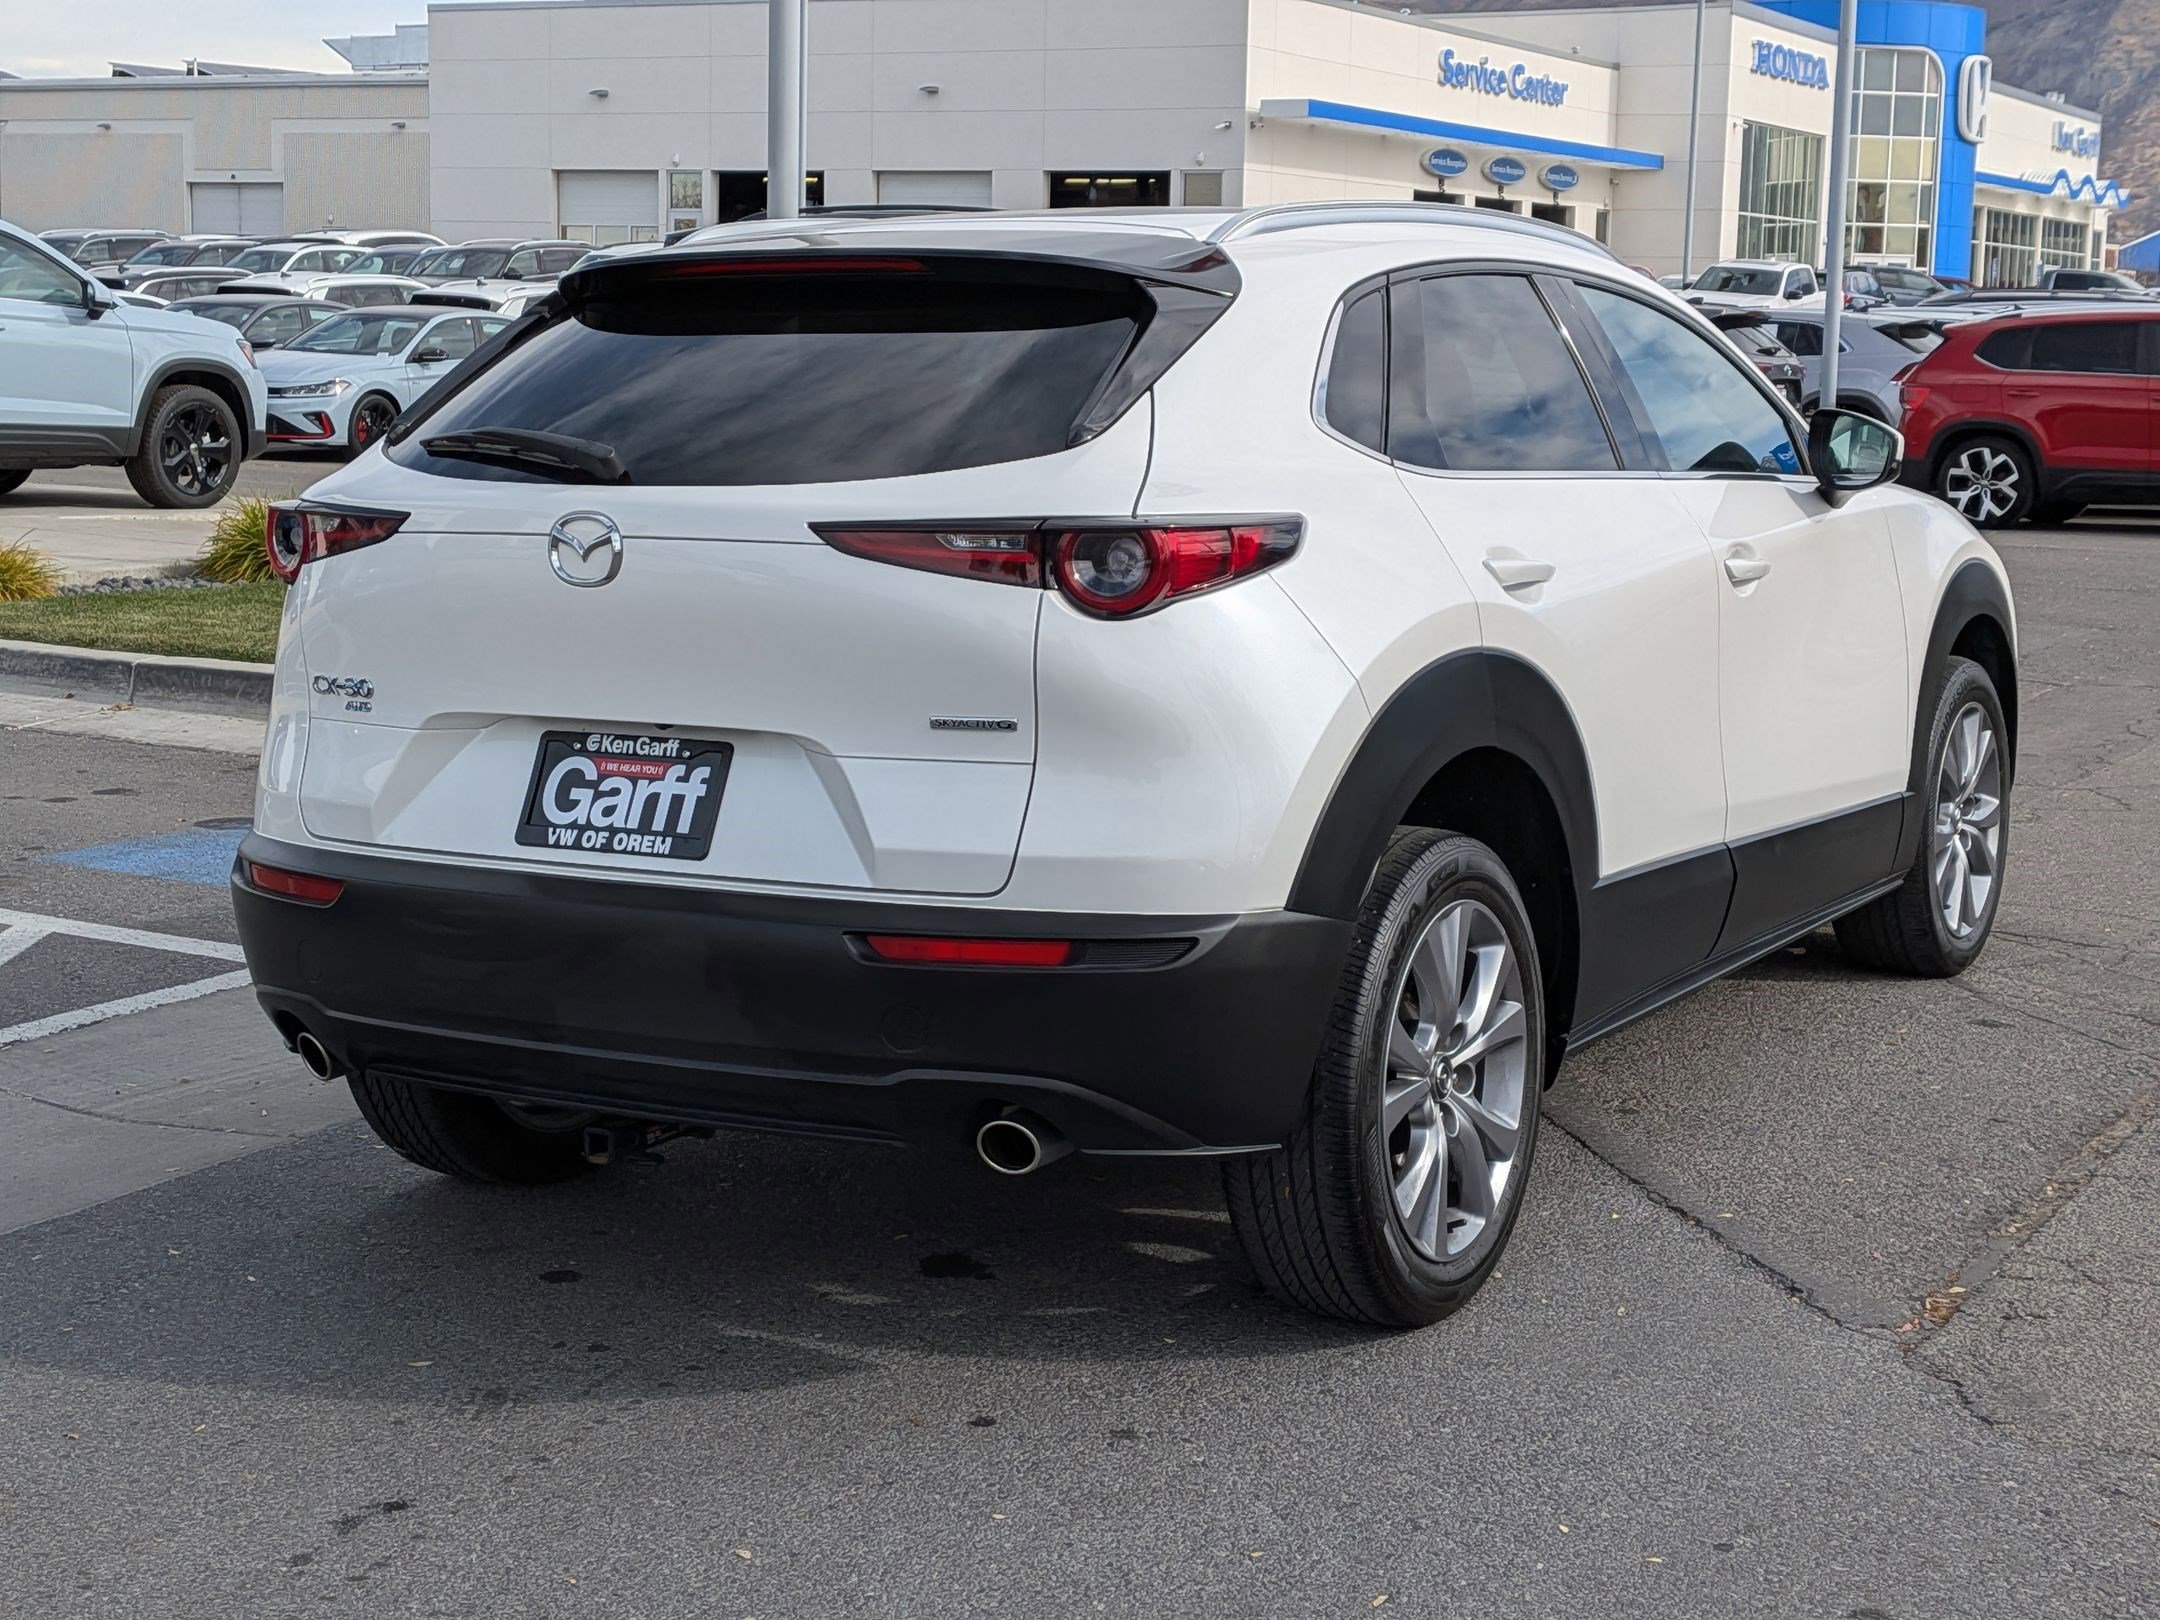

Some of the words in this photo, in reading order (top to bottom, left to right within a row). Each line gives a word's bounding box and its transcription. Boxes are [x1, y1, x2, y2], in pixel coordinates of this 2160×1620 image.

[1437, 48, 1507, 95] Service
[1507, 63, 1568, 107] Center
[1750, 39, 1830, 91] HONDA
[312, 674, 375, 699] CX-30
[601, 734, 634, 755] Ken
[635, 736, 681, 758] Garff
[606, 762, 619, 771] WE
[619, 763, 641, 773] HEAR
[642, 765, 659, 774] YOU
[542, 755, 711, 834] Garff
[547, 827, 579, 846] VW
[581, 830, 610, 850] OF
[613, 833, 673, 855] OREM
